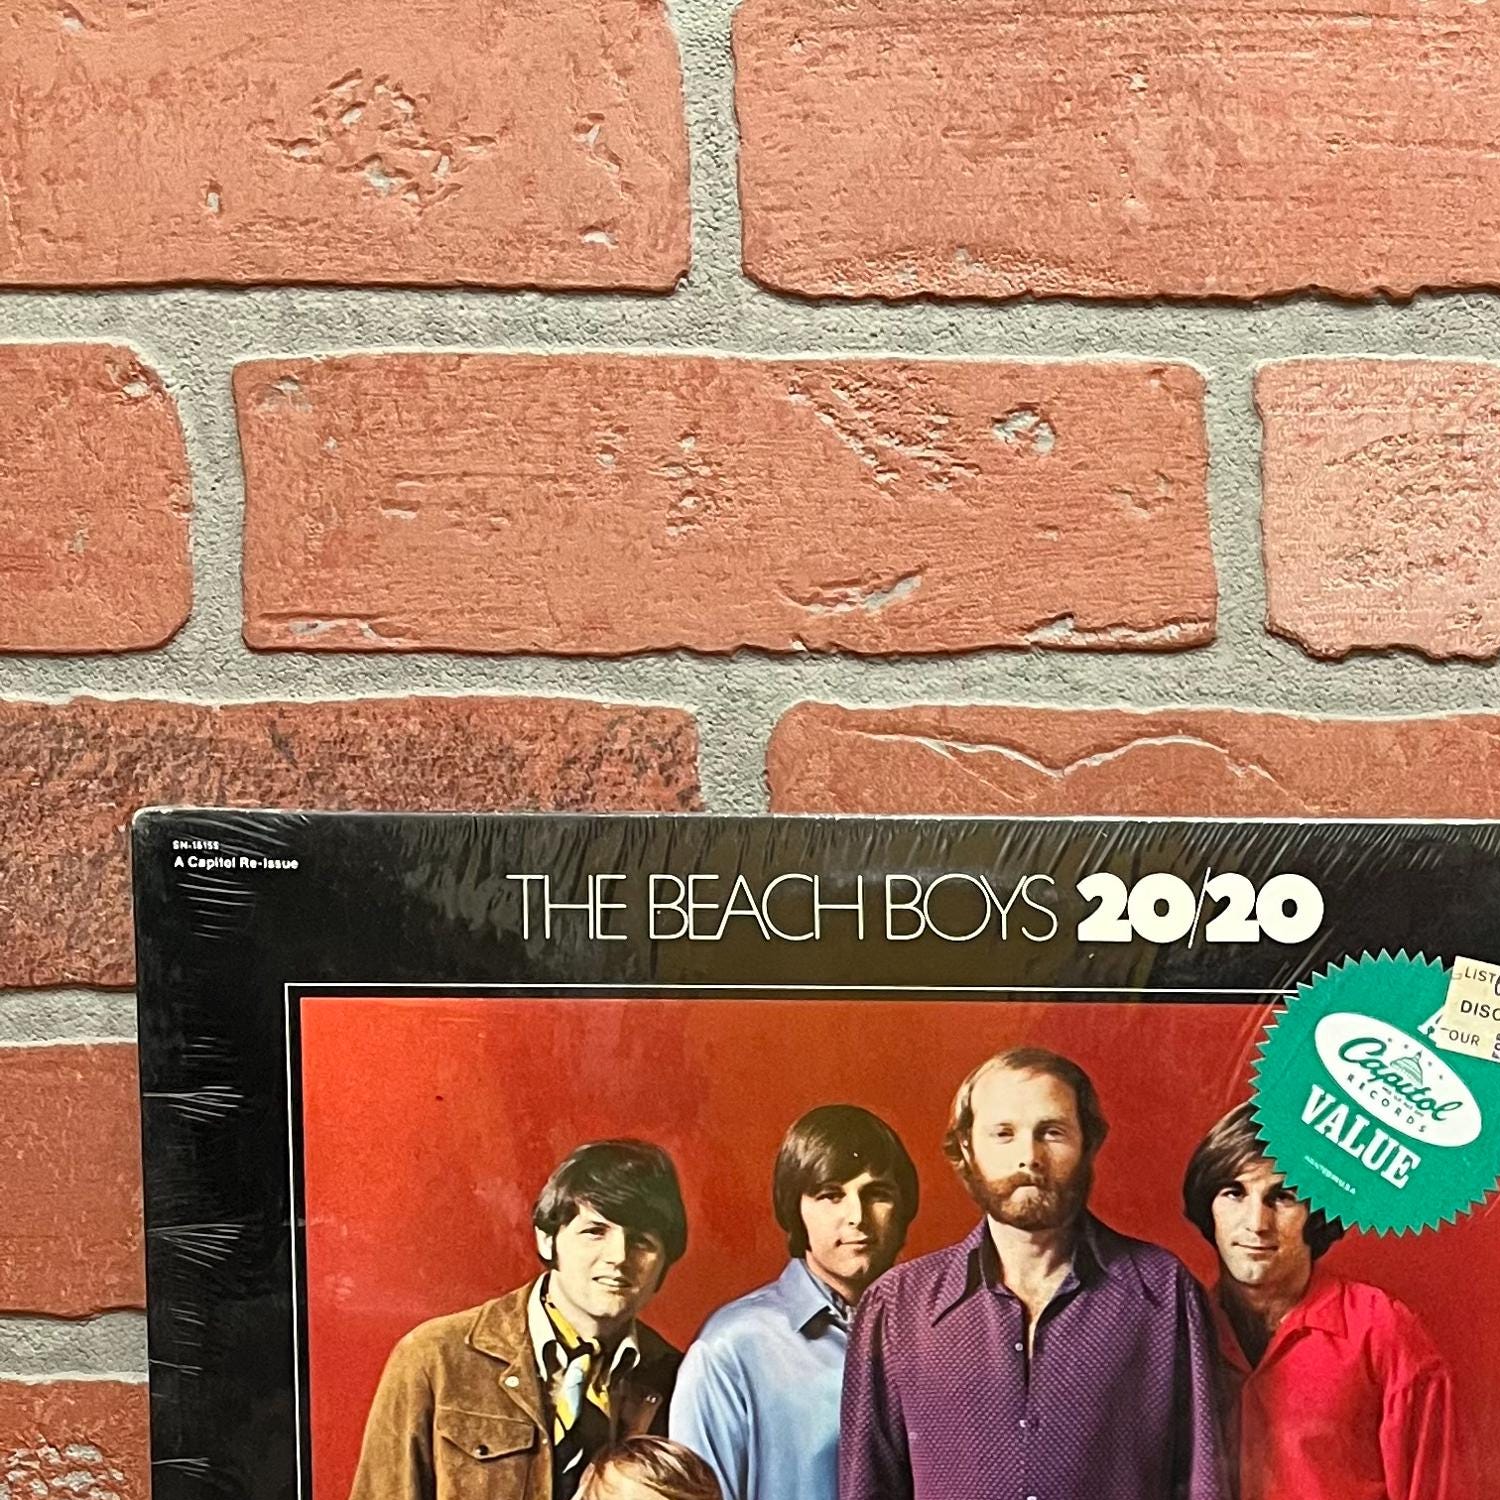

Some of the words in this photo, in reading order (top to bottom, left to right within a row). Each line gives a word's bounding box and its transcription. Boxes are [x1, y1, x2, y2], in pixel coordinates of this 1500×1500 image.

[174, 855, 185, 868] A
[187, 855, 236, 870] Capitol
[239, 856, 299, 870] Re-Issue
[505, 873, 627, 941] THE
[648, 873, 865, 942] BEACH
[884, 872, 1059, 943] BOYS
[1075, 866, 1325, 950] 20/20
[1464, 966, 1497, 985] LIST
[1448, 1028, 1481, 1047] OUR
[1338, 1037, 1463, 1122] Capitol
[1346, 1072, 1428, 1134] RECORDS
[1300, 1083, 1422, 1190] VALUE
